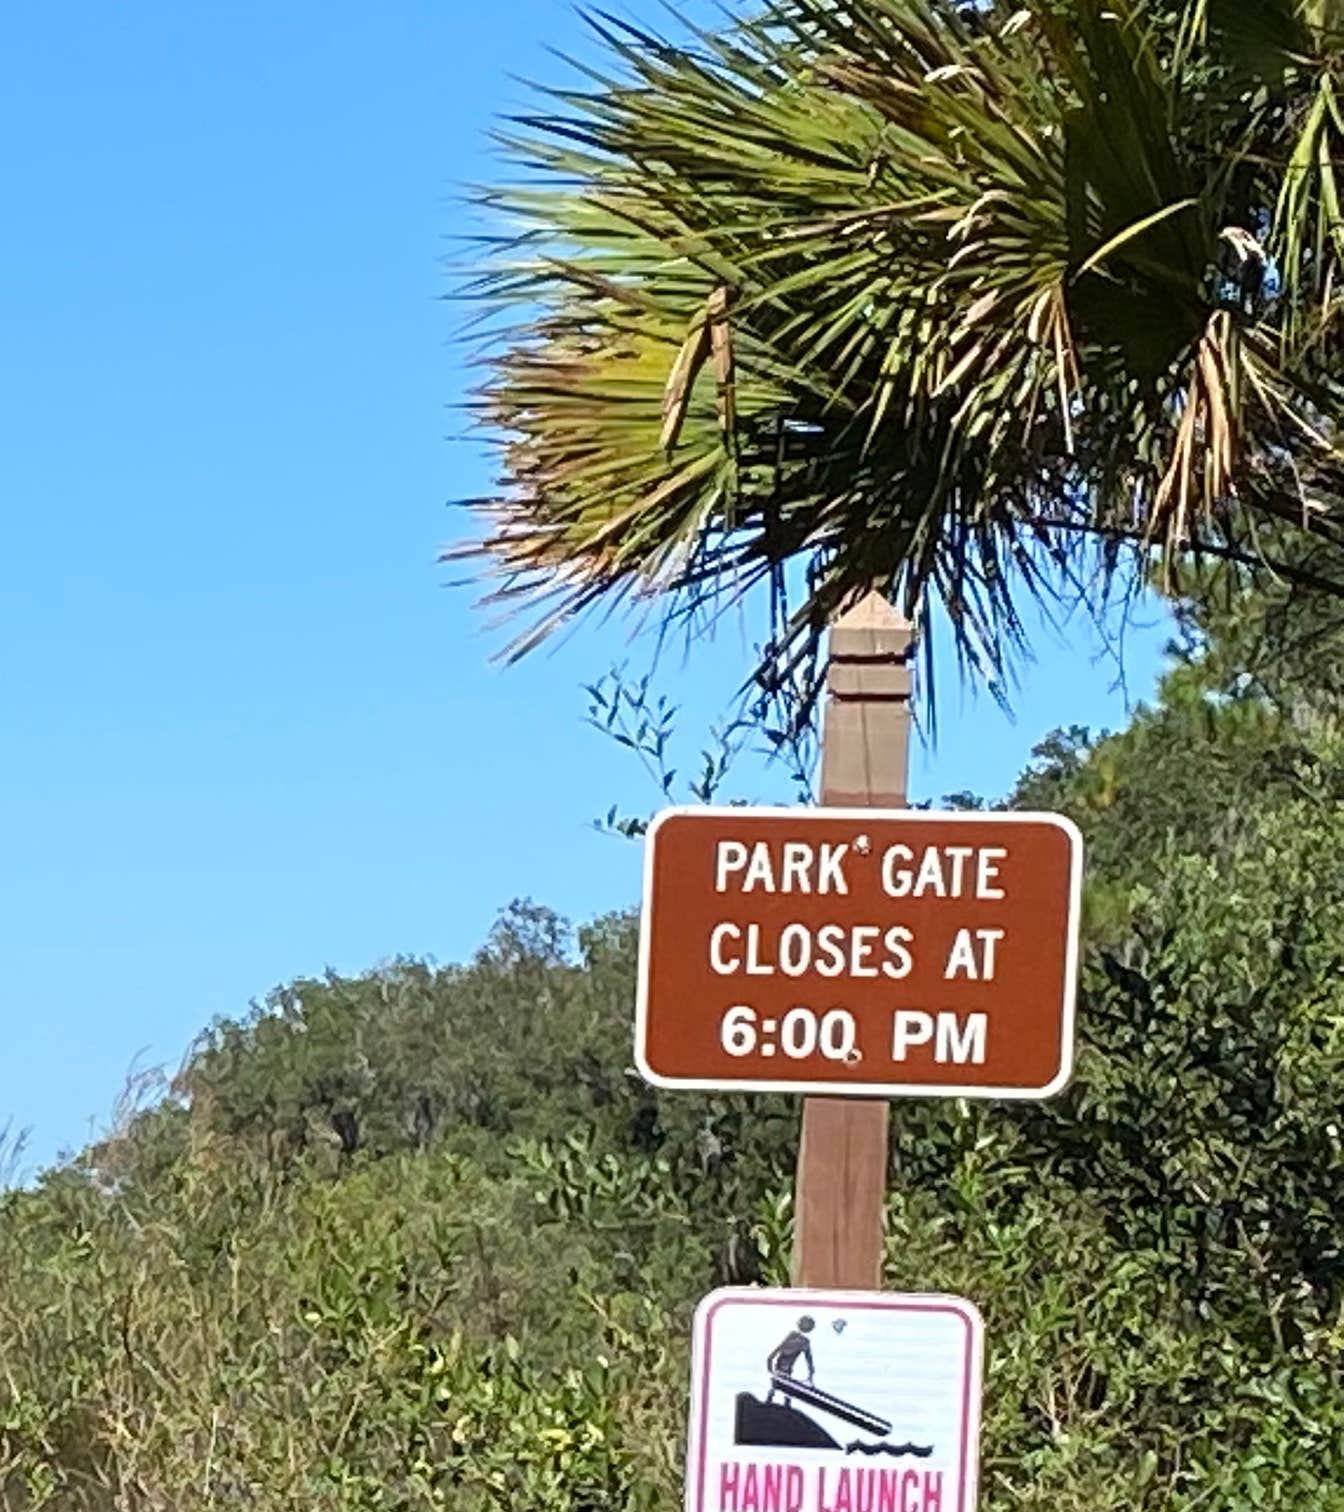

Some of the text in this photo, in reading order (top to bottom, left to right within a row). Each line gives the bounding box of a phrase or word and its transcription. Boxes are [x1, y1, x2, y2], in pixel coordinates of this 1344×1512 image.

[714, 840, 1008, 900] PARK GATE
[710, 922, 1005, 981] CLOSES AT
[720, 1004, 989, 1065] 6:00 PM
